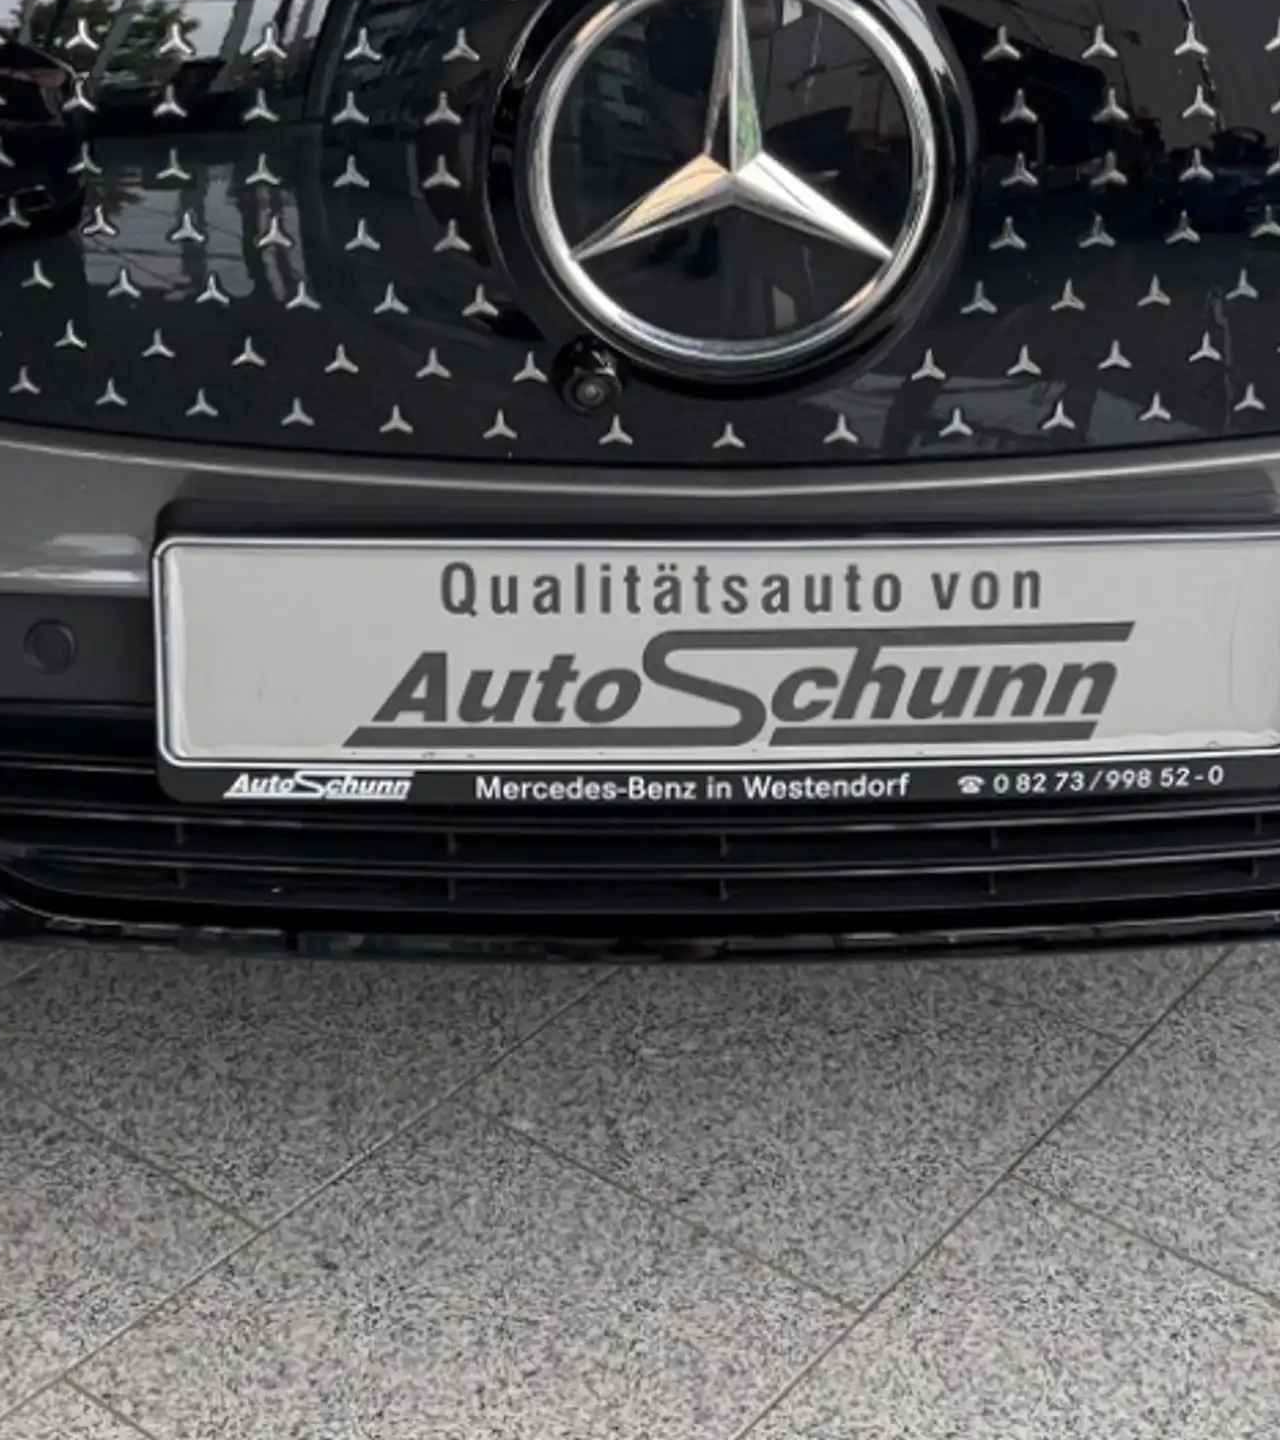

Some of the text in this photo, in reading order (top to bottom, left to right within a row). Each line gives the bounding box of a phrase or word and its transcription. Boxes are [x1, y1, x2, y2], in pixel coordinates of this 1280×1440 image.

[440, 561, 1042, 617] Qualitätsauto von
[474, 772, 911, 801] Mercedes-Benz in Westendorf
[1159, 764, 1225, 789] 52-0
